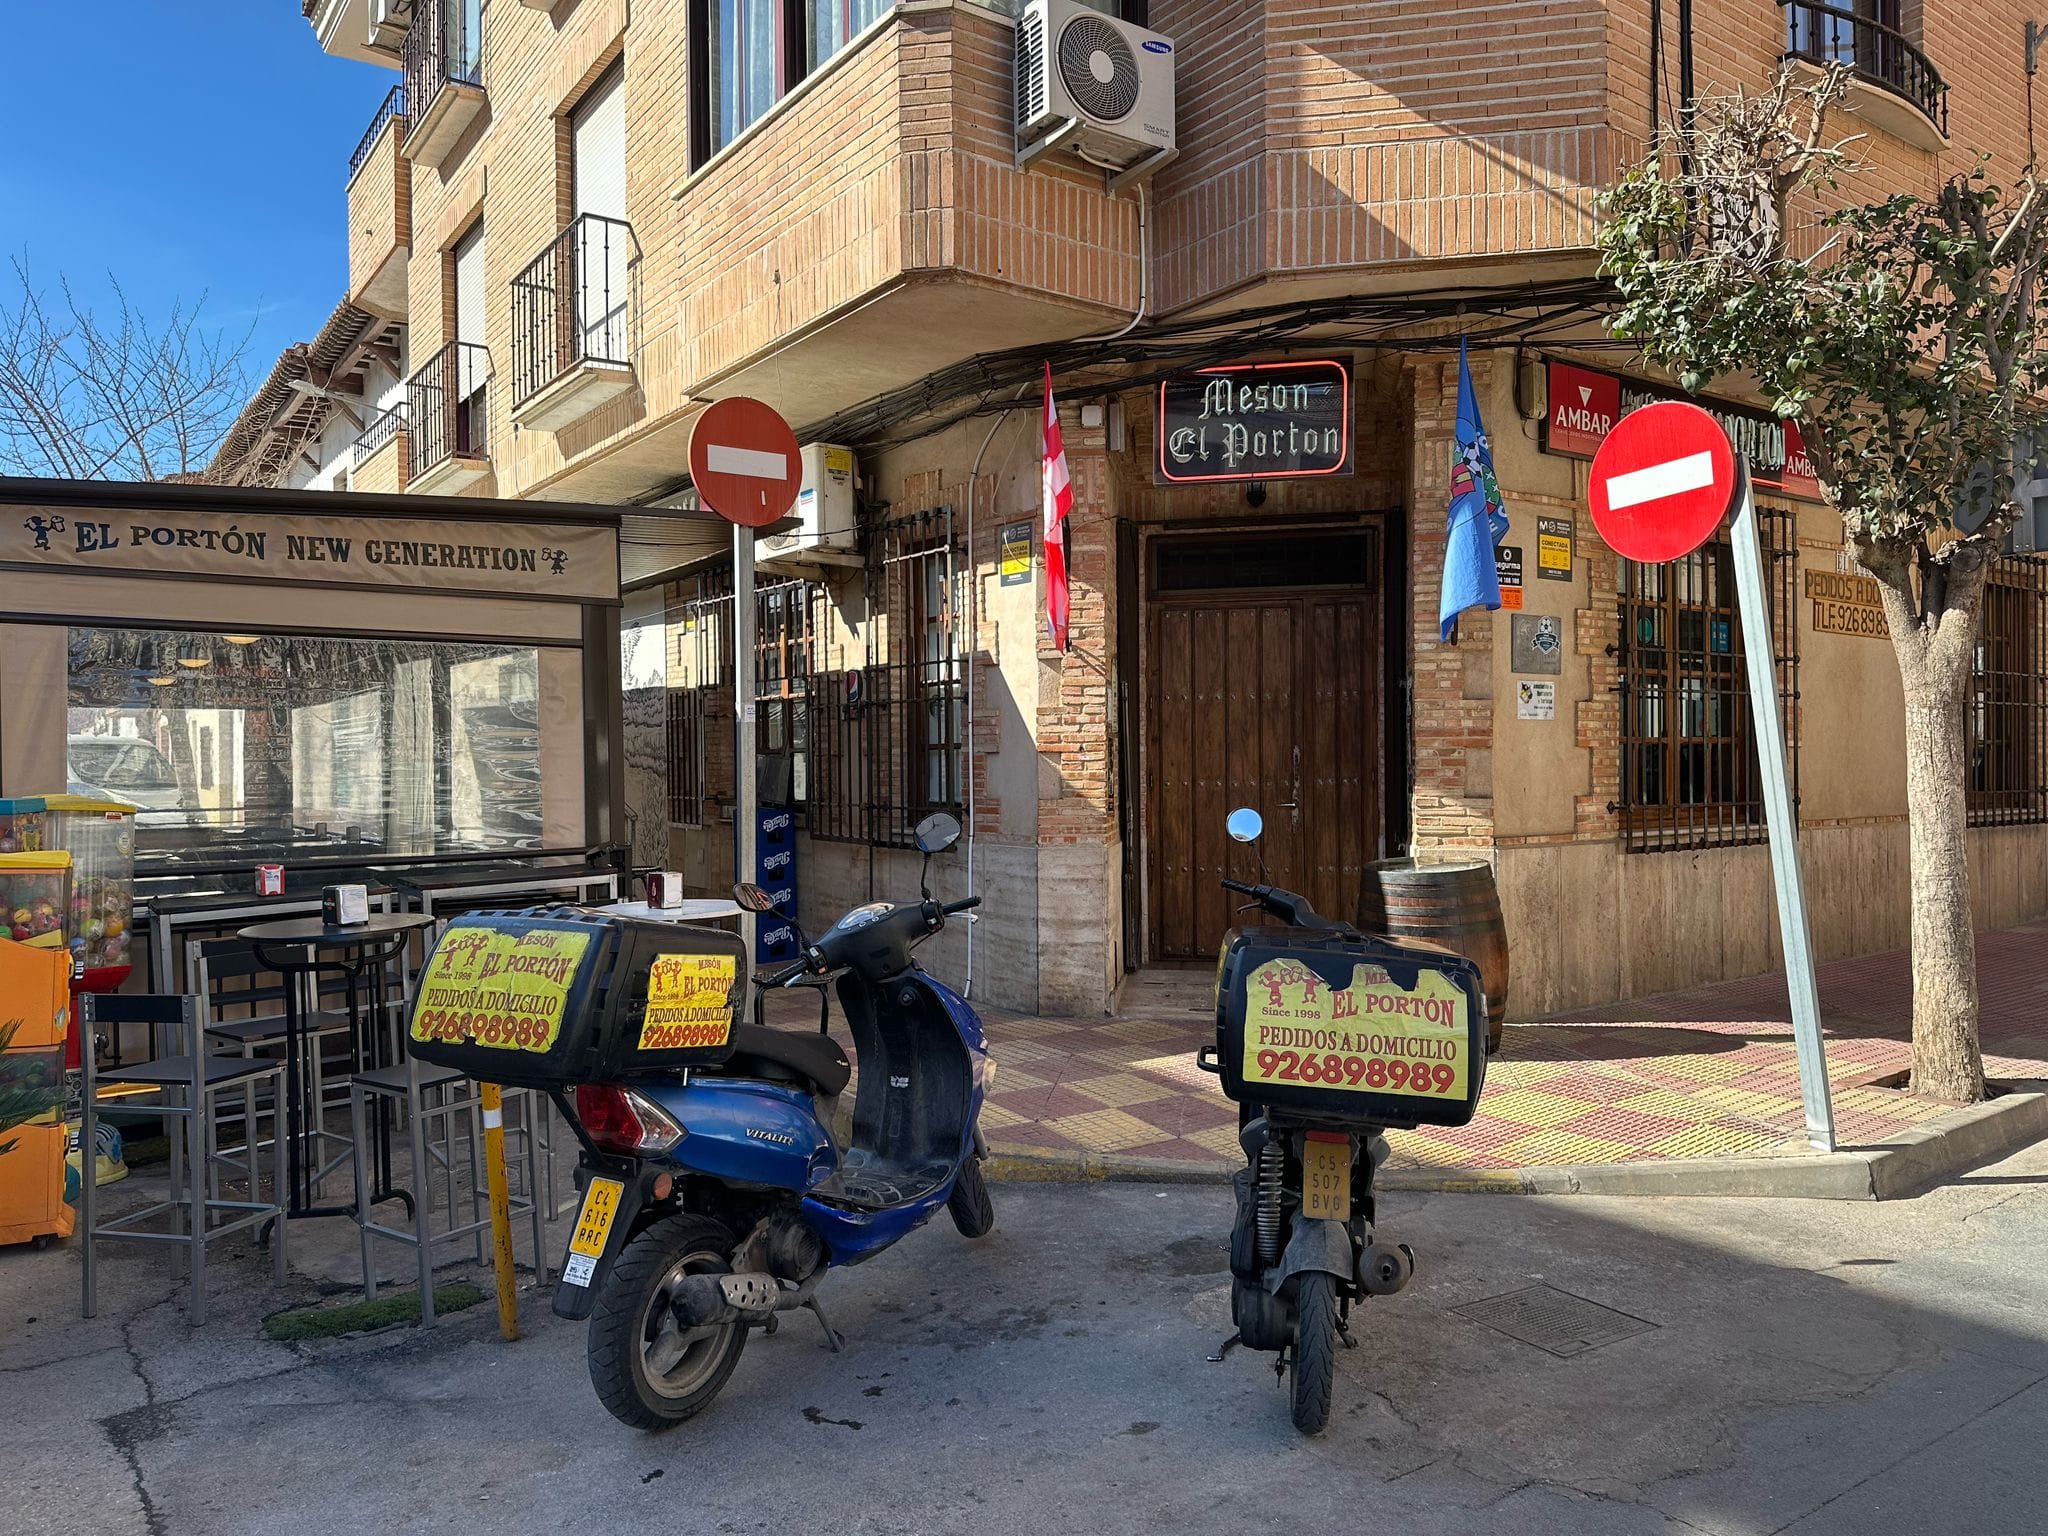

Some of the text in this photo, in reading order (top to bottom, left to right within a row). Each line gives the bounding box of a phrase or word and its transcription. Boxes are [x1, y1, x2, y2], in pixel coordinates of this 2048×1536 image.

[1199, 377, 1309, 420] Meson
[1556, 405, 1611, 434] AMBAR
[1169, 421, 1340, 467] El Porton
[75, 521, 537, 572] EL PORTÓN NEW GENERATION
[1807, 572, 1882, 605] PEDIDOS A DO
[514, 933, 558, 949] MESÓN
[434, 970, 472, 981] Since 1998
[478, 952, 573, 985] EL PORTÓN
[683, 975, 697, 999] EL
[425, 988, 558, 1016] PEDIDOS A DOMICILIO
[648, 1007, 684, 1024] PEDIDOS
[1262, 1007, 1321, 1020] Since 1998
[1332, 990, 1455, 1029] EL PORTÓN
[419, 1009, 550, 1048] 926898989
[643, 1023, 727, 1048] 926898989
[1259, 1025, 1457, 1061] PEDIDOS A DOMICILIO
[1257, 1049, 1456, 1094] 926898989
[1312, 1173, 1340, 1190] 507
[594, 1190, 610, 1207] C4
[585, 1208, 608, 1227] 616
